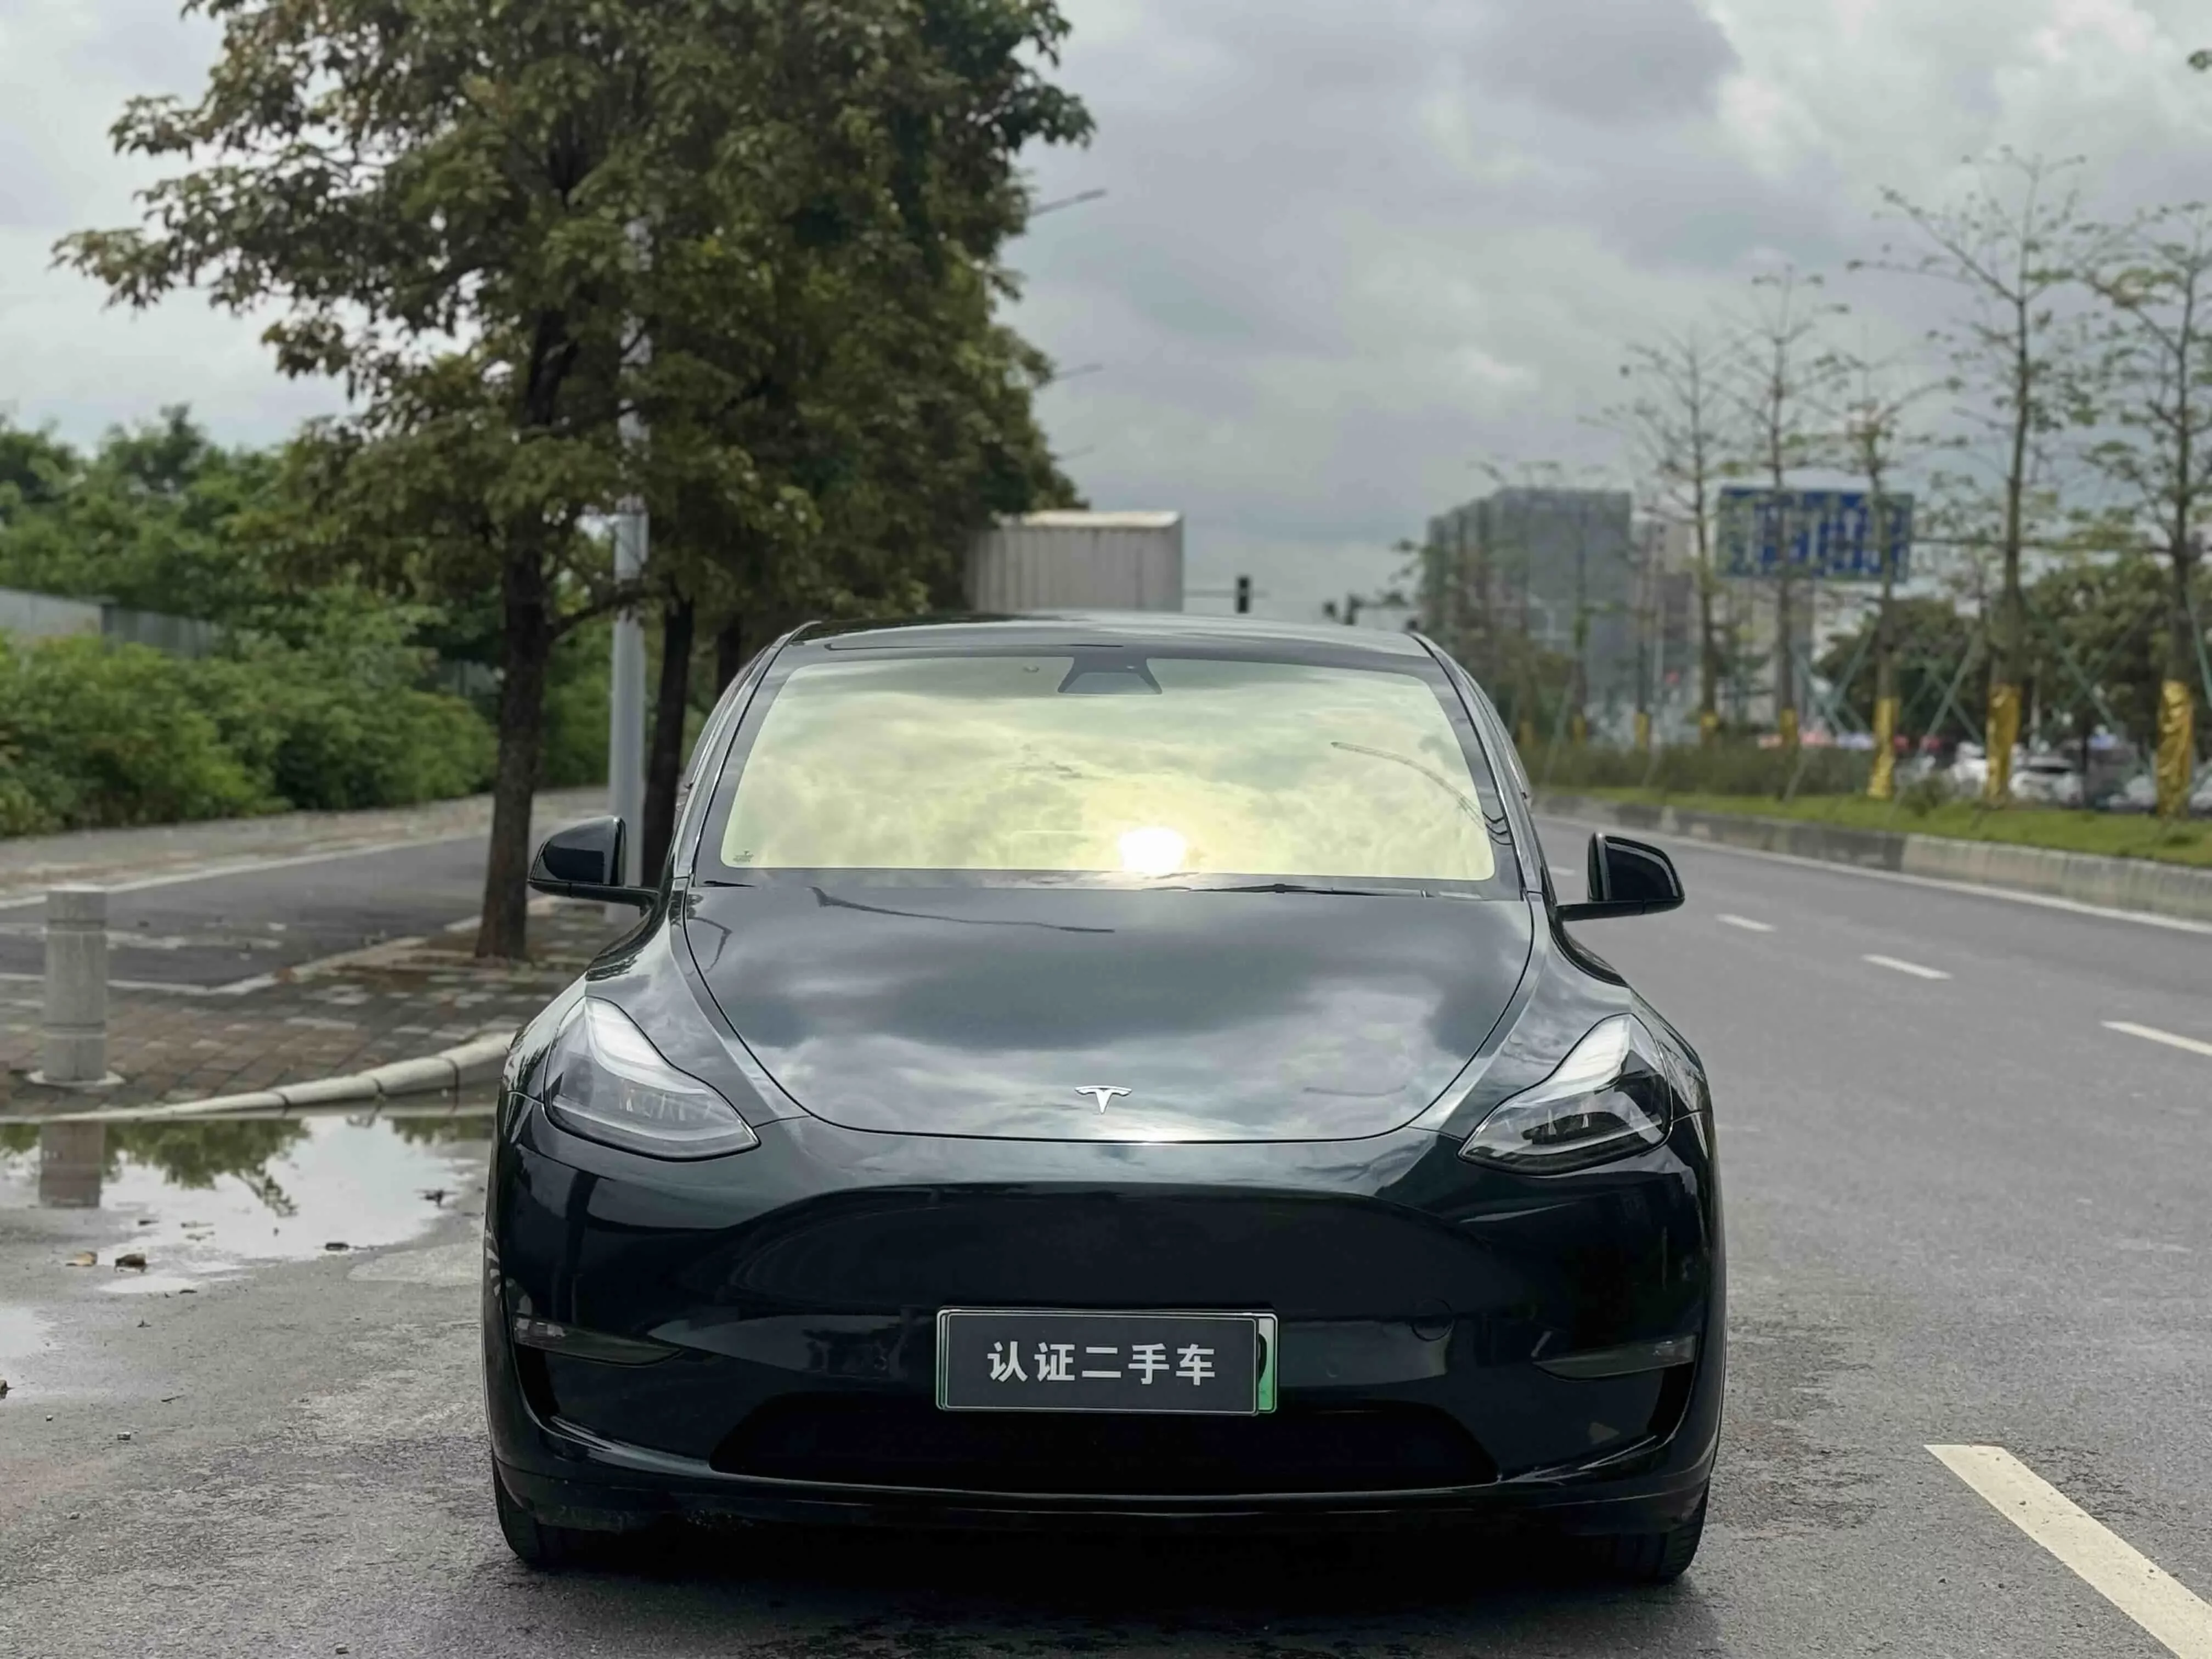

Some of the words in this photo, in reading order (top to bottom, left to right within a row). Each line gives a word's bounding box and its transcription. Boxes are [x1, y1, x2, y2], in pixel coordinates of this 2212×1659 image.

[987, 1341, 1215, 1386] 认证二手车
